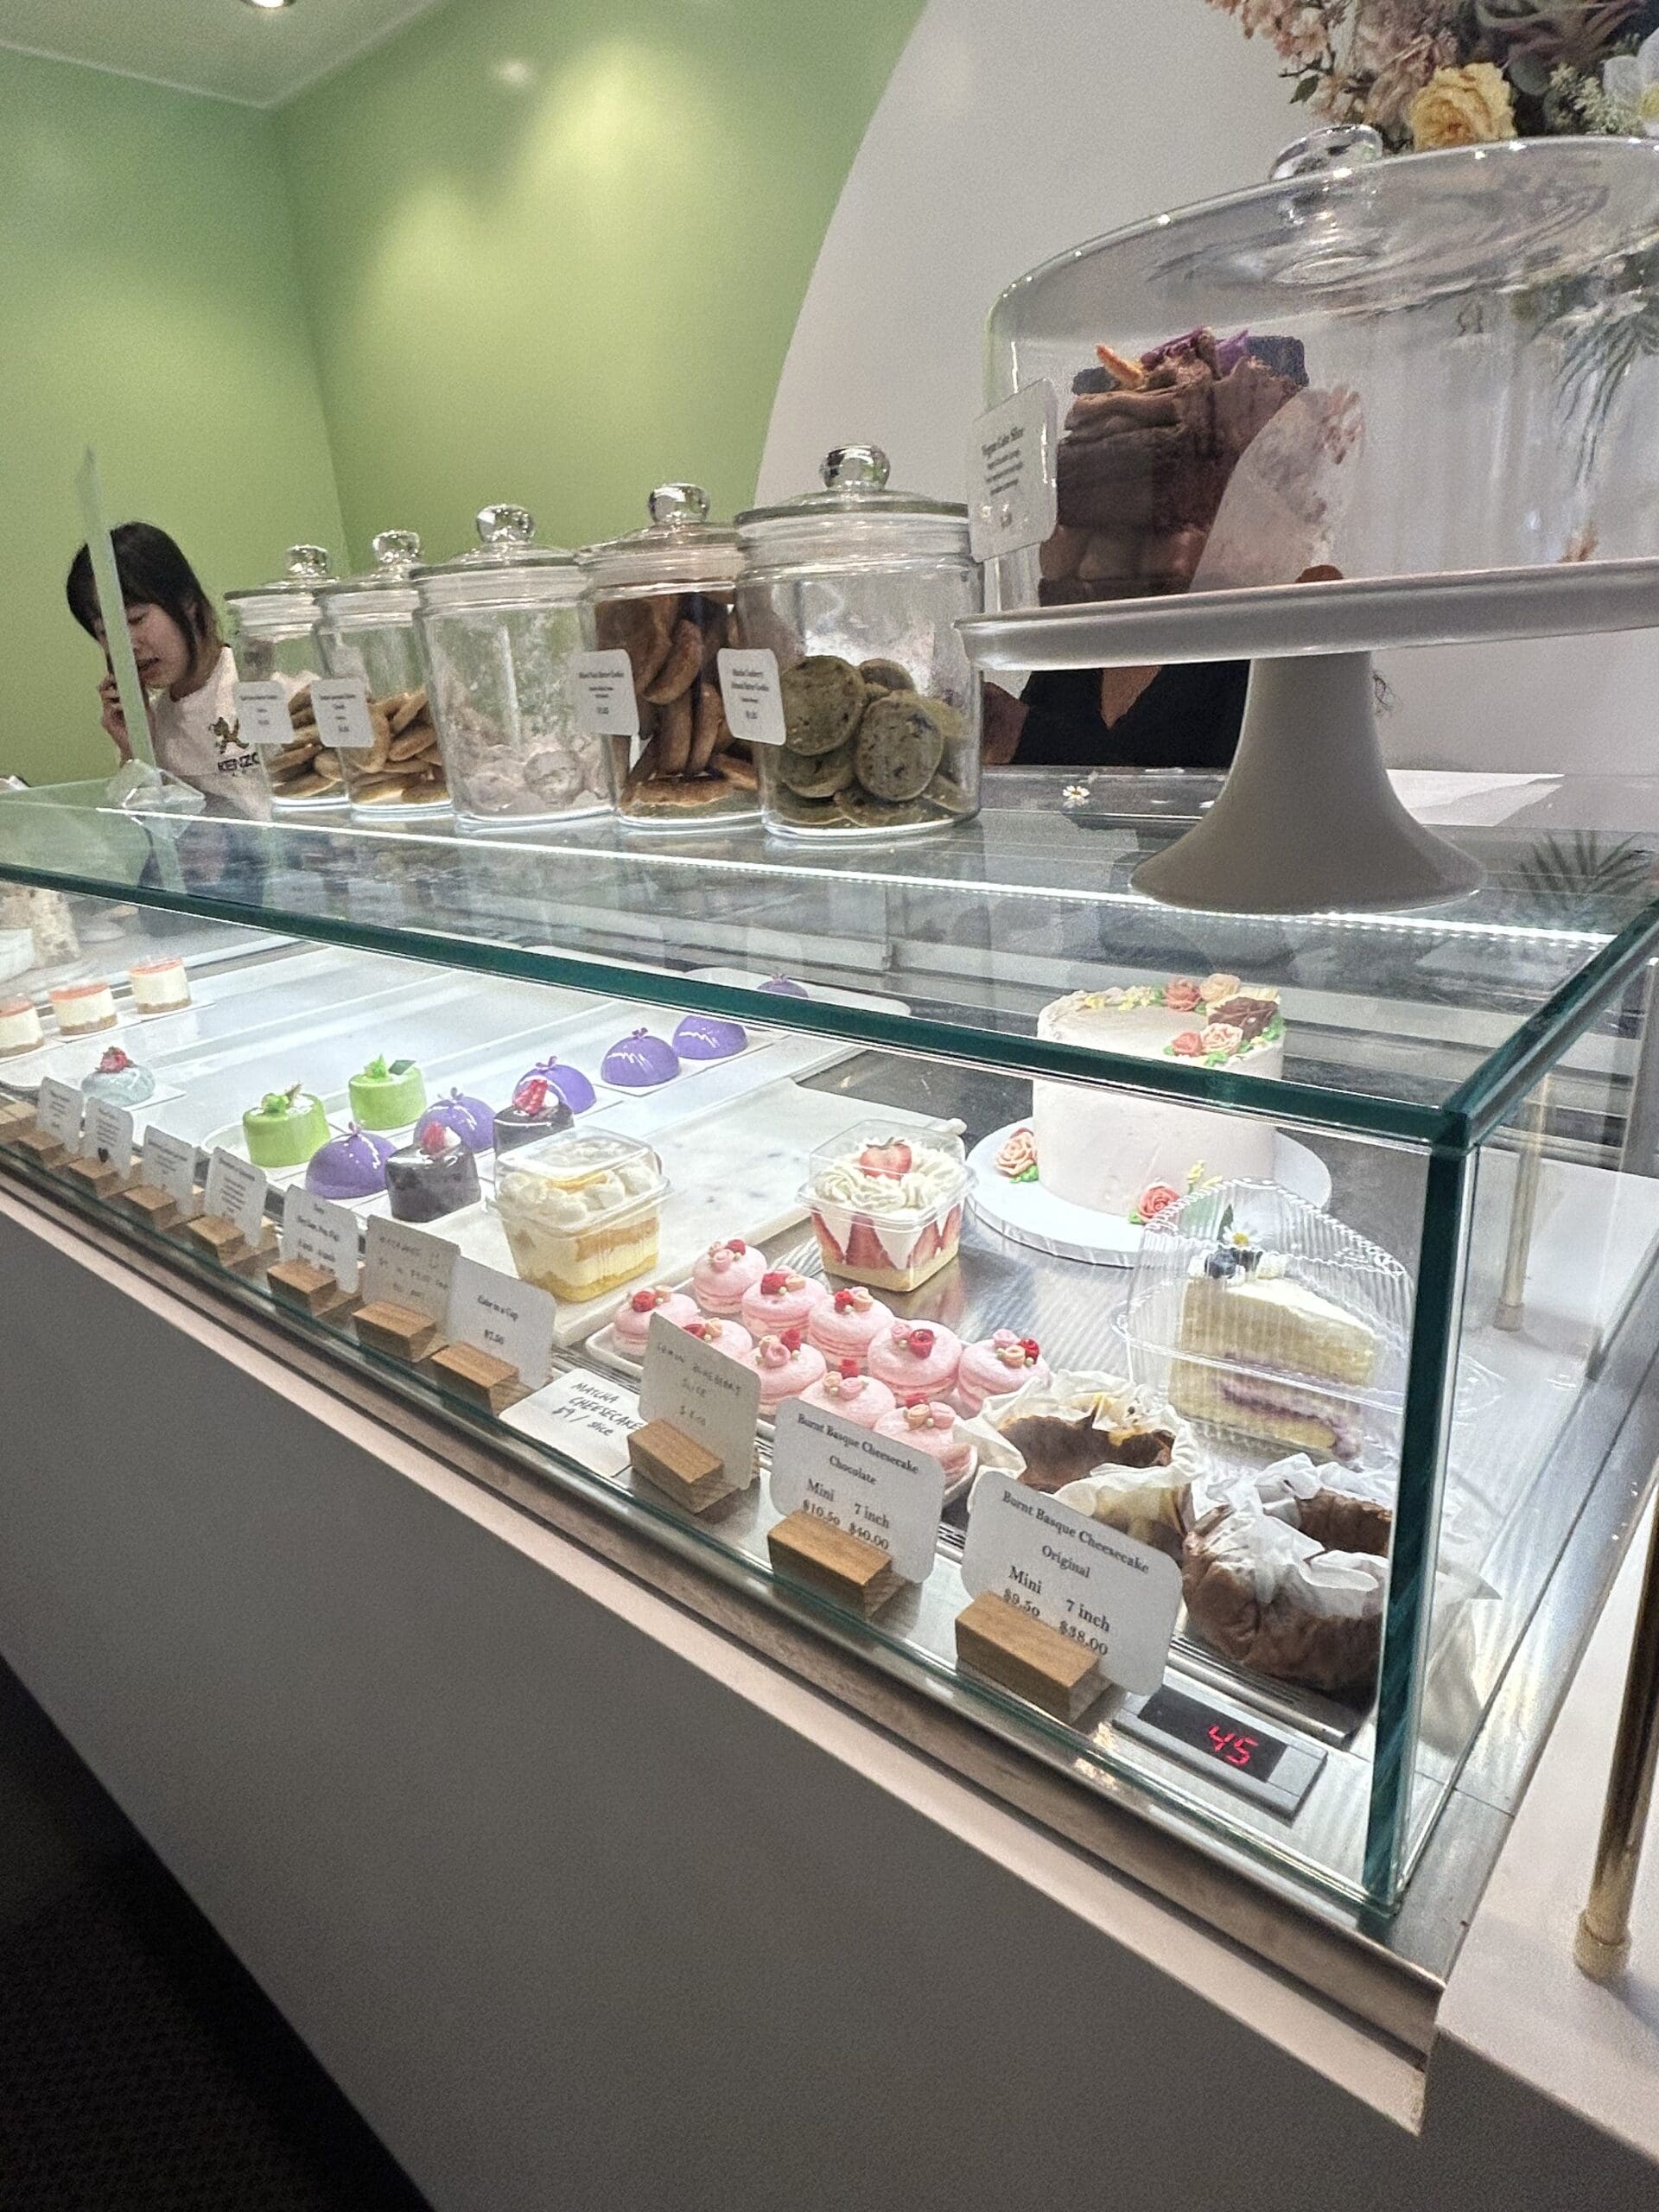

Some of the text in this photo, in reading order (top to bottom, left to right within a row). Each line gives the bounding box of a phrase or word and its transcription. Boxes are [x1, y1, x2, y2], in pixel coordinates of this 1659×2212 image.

[570, 1382, 620, 1403] MATCHA
[588, 1421, 614, 1436] slice
[798, 1413, 919, 1475] Burnt Basque Cheesecake
[829, 1454, 878, 1486] Chocolate
[802, 1498, 841, 1527] $10.50
[805, 1478, 890, 1529] Mini 7 inch
[1001, 1490, 1151, 1575] Burnt Basque Cheesecake
[1041, 1544, 1091, 1579] Original
[1007, 1565, 1112, 1633] Mini 7 inch
[1002, 1587, 1109, 1656] $9.50 $38.00
[1207, 1724, 1259, 1767] 45
